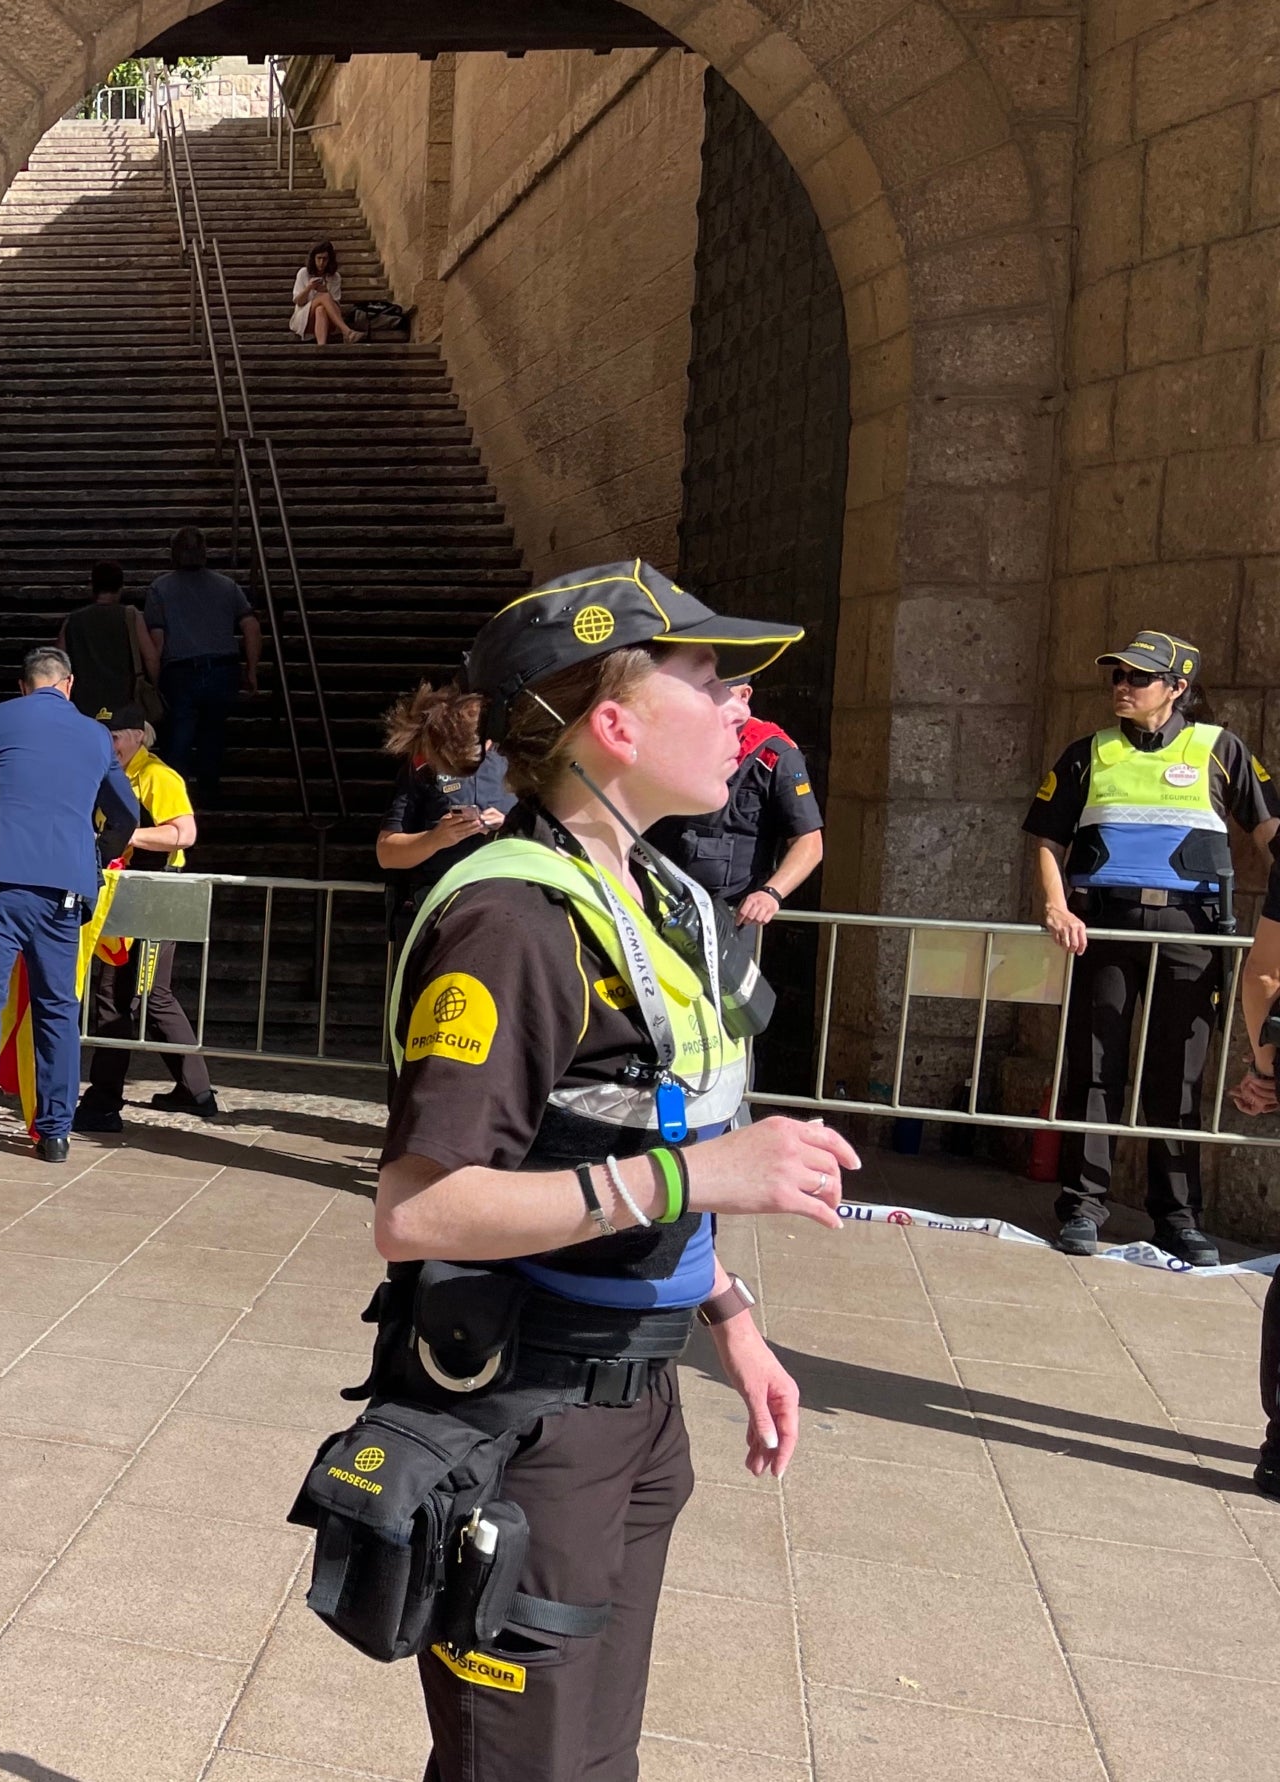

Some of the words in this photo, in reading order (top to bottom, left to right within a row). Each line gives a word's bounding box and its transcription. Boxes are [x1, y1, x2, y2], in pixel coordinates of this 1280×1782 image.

[411, 1031, 482, 1053] PROSEGUR
[327, 1466, 383, 1495] PROSEGUR
[439, 1642, 515, 1683] RSEGUR
